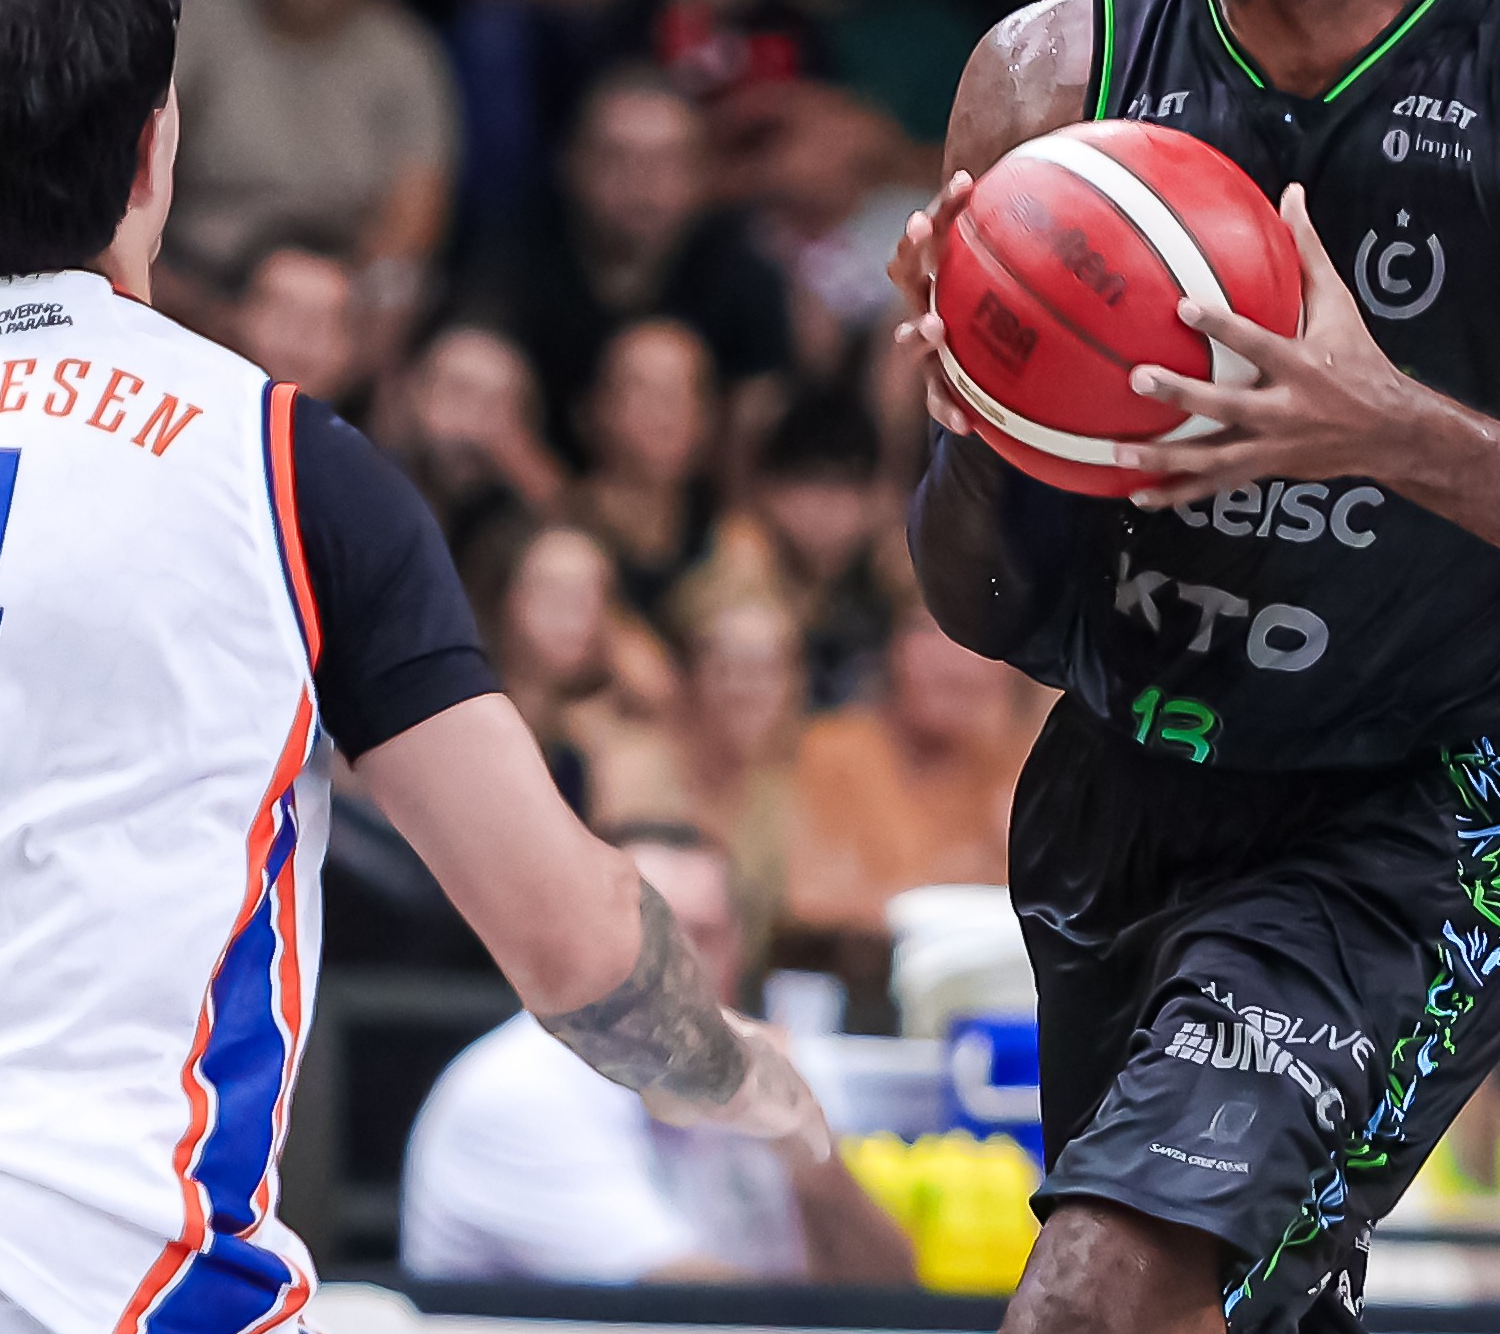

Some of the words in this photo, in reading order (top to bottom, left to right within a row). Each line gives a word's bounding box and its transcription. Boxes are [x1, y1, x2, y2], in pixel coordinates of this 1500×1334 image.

[1392, 95, 1478, 130] ATLET
[1114, 551, 1330, 672] KTO
[1132, 686, 1226, 764] 13
